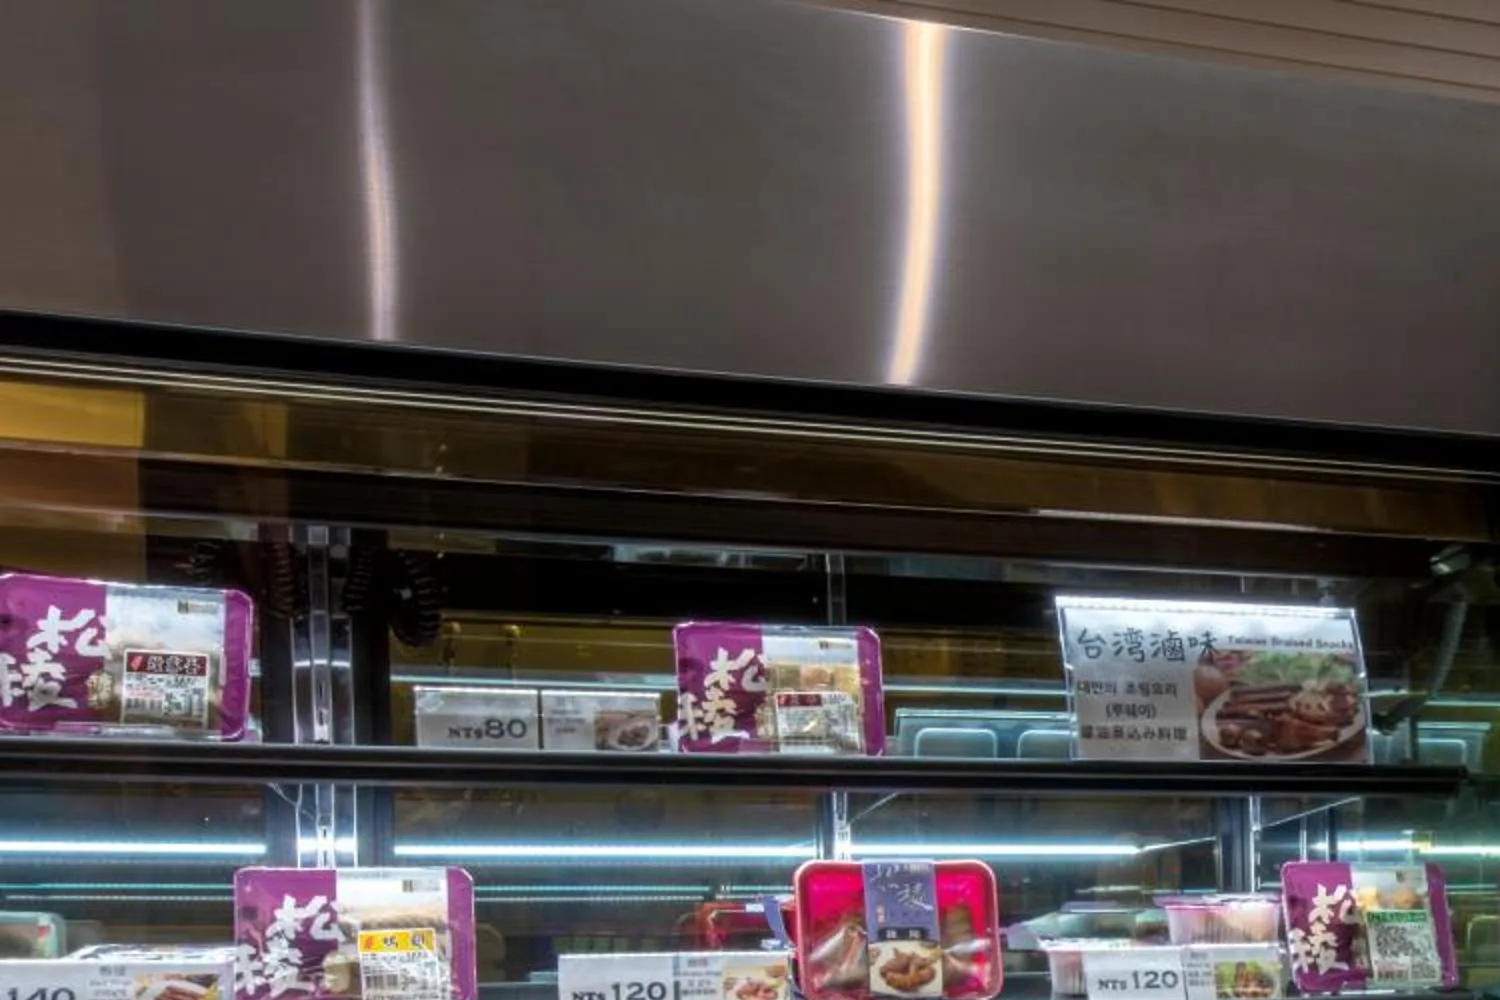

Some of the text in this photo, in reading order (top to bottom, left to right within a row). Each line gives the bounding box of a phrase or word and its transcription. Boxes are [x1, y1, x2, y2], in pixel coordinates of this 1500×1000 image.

[1271, 634, 1313, 649] Braised
[447, 717, 528, 742] NT$80
[1096, 970, 1180, 993] NT$120
